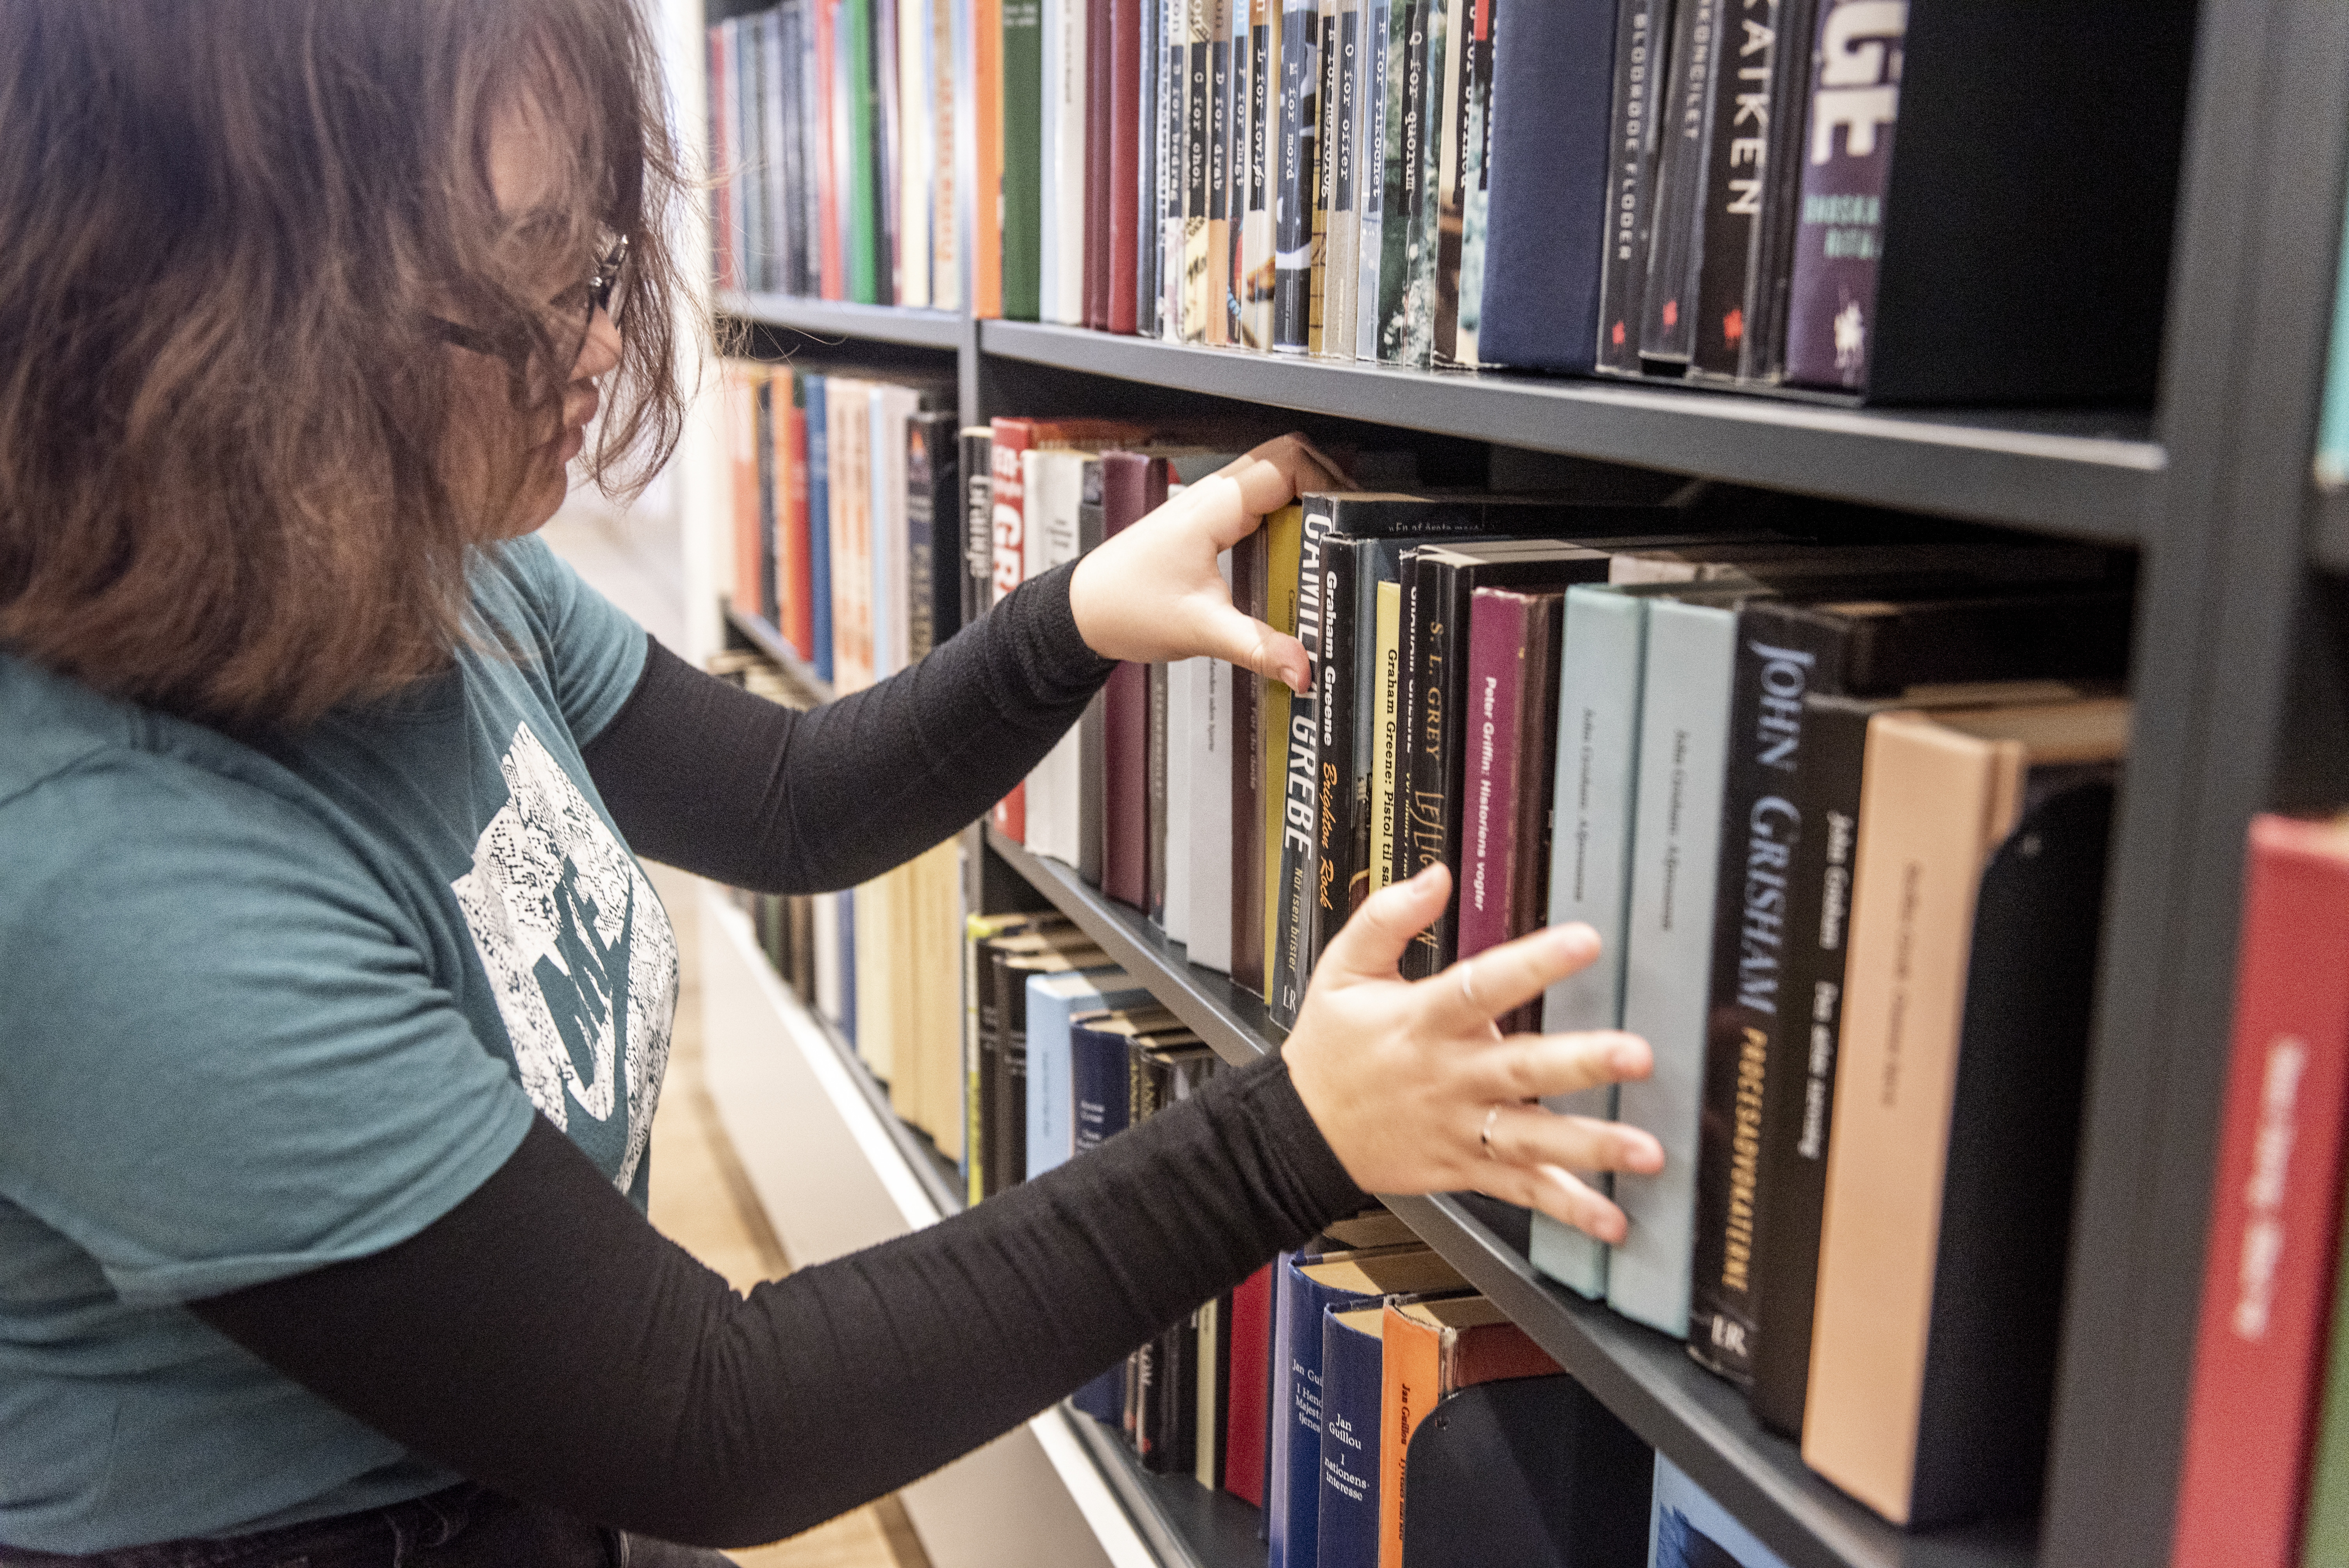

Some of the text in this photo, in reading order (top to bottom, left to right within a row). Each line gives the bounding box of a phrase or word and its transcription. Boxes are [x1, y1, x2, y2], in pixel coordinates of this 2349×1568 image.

[1379, 21, 1387, 35] R
[1257, 48, 1266, 62] L
[1172, 87, 1180, 120] for
[1237, 92, 1245, 127] for
[1256, 73, 1265, 109] for
[1341, 44, 1354, 181] O for offer
[1405, 31, 1422, 191] Q for quorum
[1193, 96, 1202, 131] for
[1213, 72, 1225, 190] D for drab
[1287, 62, 1297, 180] M for mord
[1373, 99, 1383, 198] rikochet
[1324, 571, 1337, 747] Graham Greene
[1387, 650, 1397, 714] Graham
[1426, 622, 1444, 761] S. L. GREY
[1484, 677, 1497, 720] Peter
[1385, 721, 1395, 784] Greene:
[1285, 715, 1316, 860] GREBE
[1383, 791, 1393, 837] Pistol
[1477, 780, 1491, 857] Historiens
[1737, 639, 1816, 1014] JOHN GRISHAM
[1319, 762, 1337, 911] Brighton Rock
[1383, 844, 1392, 861] til
[1475, 862, 1485, 911] vogter
[1292, 894, 1300, 923] isen
[1289, 926, 1299, 972] brister
[1283, 985, 1296, 1014] LR
[1292, 1359, 1305, 1376] Jan
[1402, 1383, 1410, 1404] Jan
[1329, 1422, 1362, 1450] Guillou
[1336, 1413, 1352, 1432] Jan
[1401, 1406, 1410, 1445] Guillou
[1341, 1453, 1345, 1465] I
[1326, 1472, 1363, 1501] interesse
